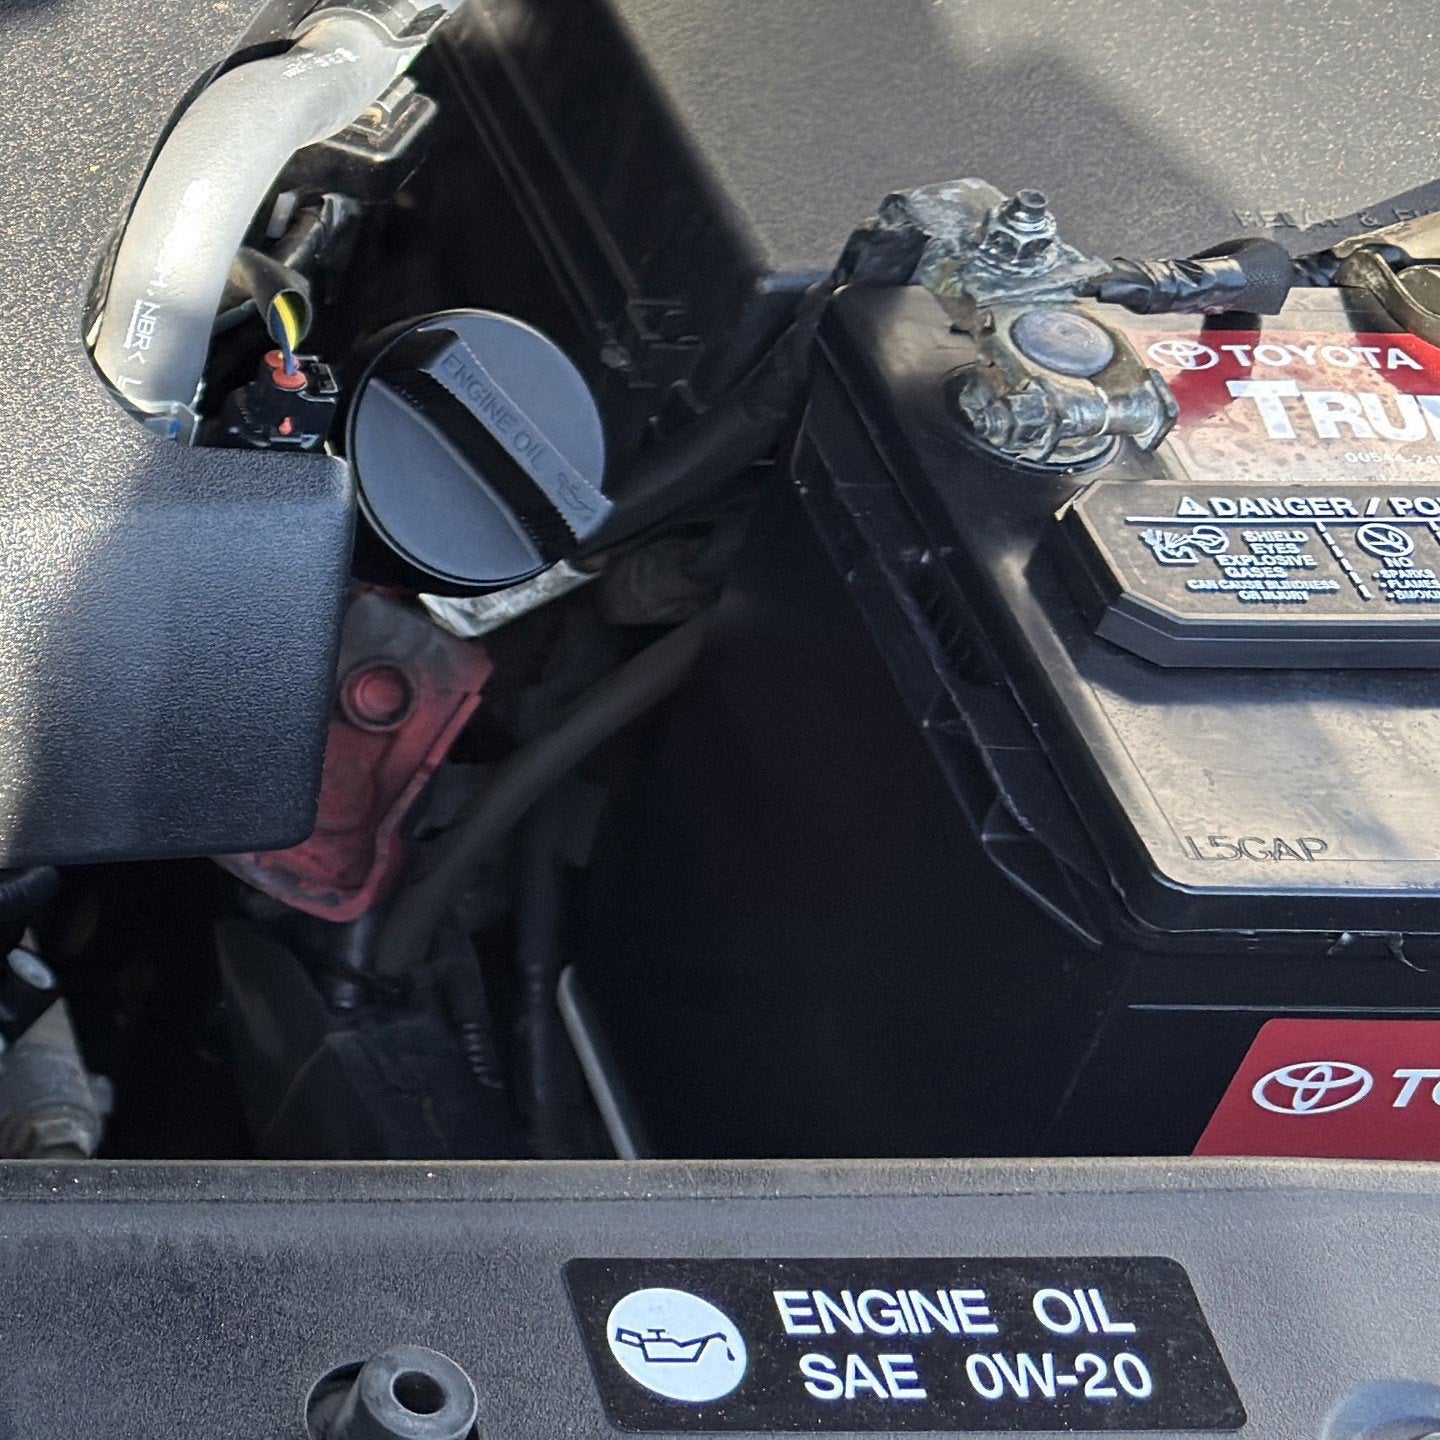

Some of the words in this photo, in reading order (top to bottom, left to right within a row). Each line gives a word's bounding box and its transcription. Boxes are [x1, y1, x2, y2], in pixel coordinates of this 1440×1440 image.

[1221, 344, 1424, 371] TOYOTA
[440, 353, 517, 434] ENGINE
[513, 431, 549, 472] OIL
[1225, 379, 1440, 442] TRU
[1207, 496, 1357, 517] DANGER
[1387, 496, 1440, 517] PO
[1242, 530, 1309, 544] SHIELD
[1249, 543, 1301, 555] EYES
[1215, 554, 1318, 567] EXPLOSIVE
[1382, 556, 1414, 569] NO
[1224, 567, 1288, 579] GASES
[1392, 1068, 1440, 1108] T
[772, 1289, 999, 1335] ENGINE
[1031, 1288, 1137, 1335] OIL
[798, 1353, 927, 1400] SAE
[965, 1351, 1153, 1400] 0W-20
